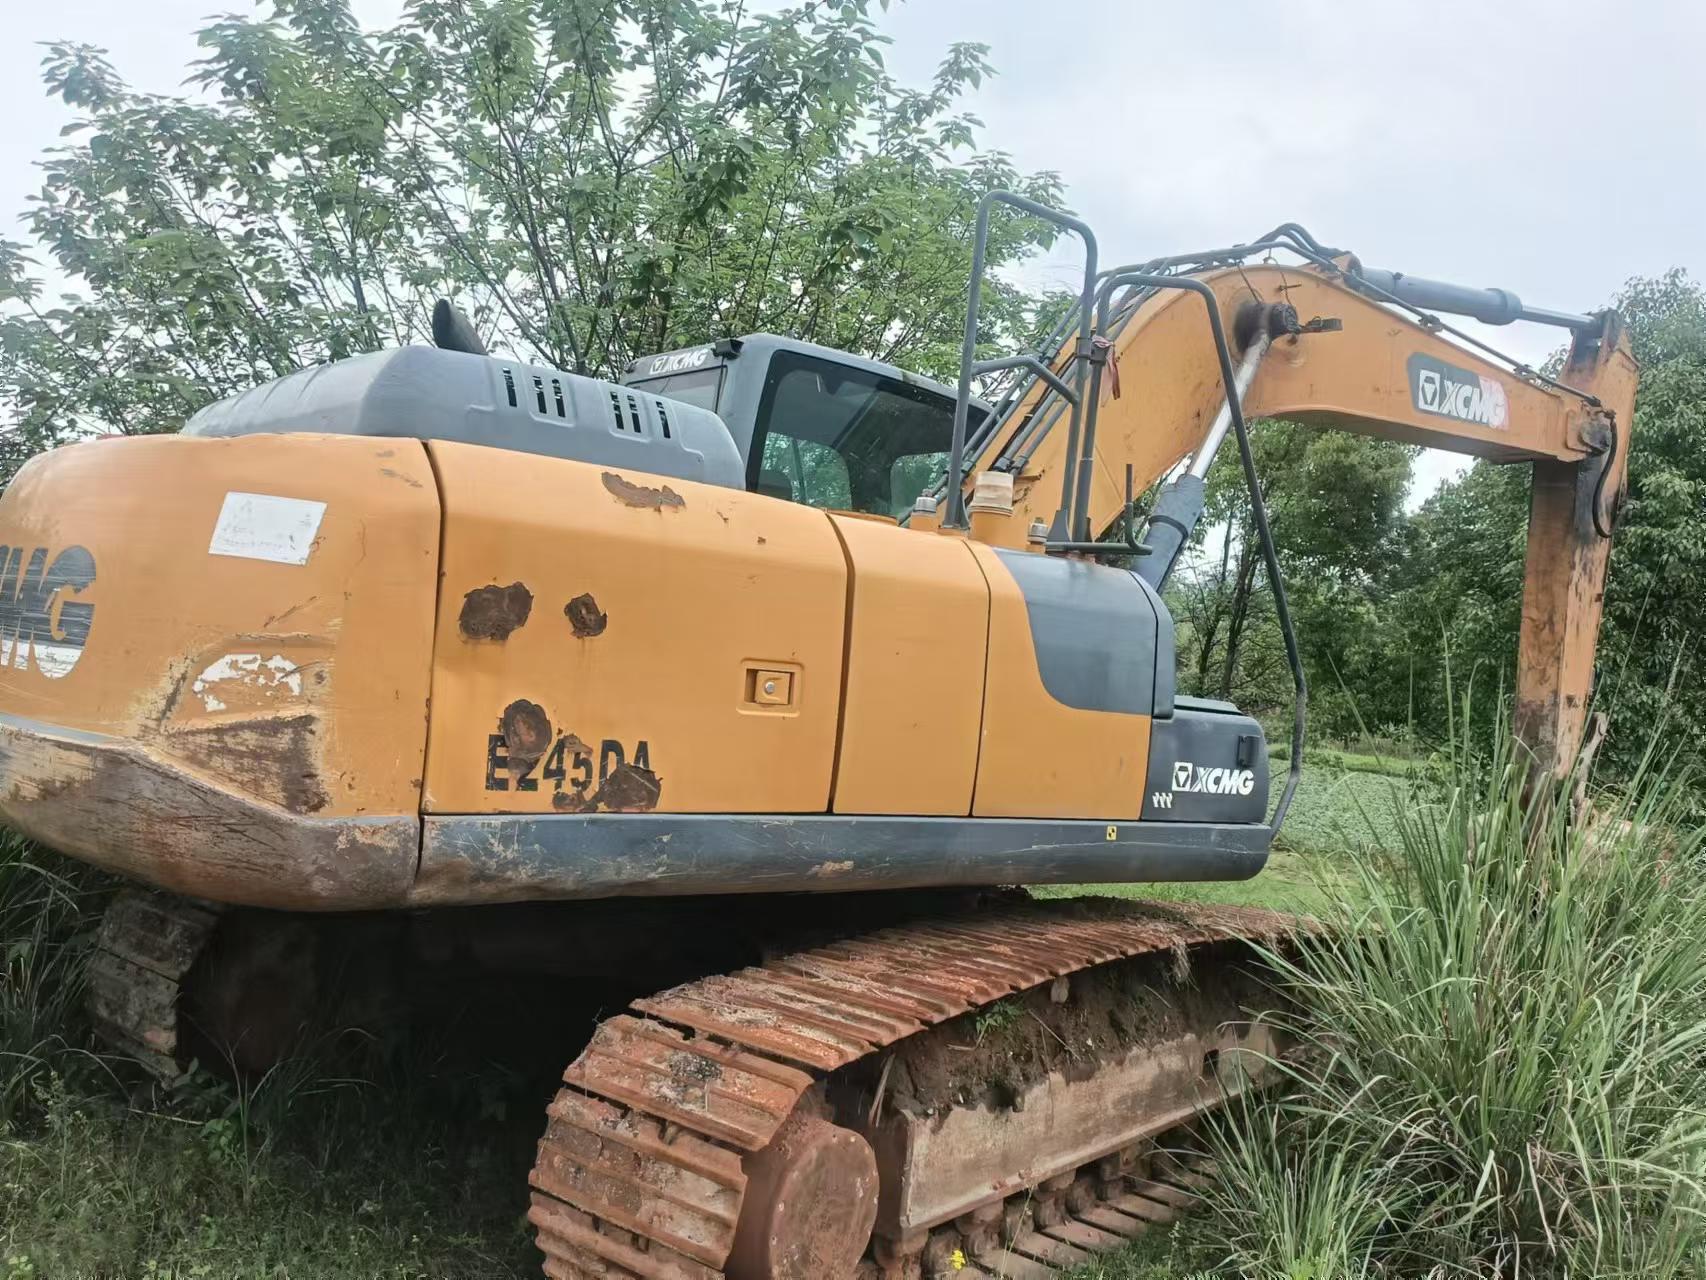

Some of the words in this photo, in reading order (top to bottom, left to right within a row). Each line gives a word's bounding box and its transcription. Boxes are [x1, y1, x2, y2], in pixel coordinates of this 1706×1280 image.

[1438, 379, 1507, 429] XCMG
[0, 544, 97, 679] MG
[1189, 766, 1255, 796] XCMG
